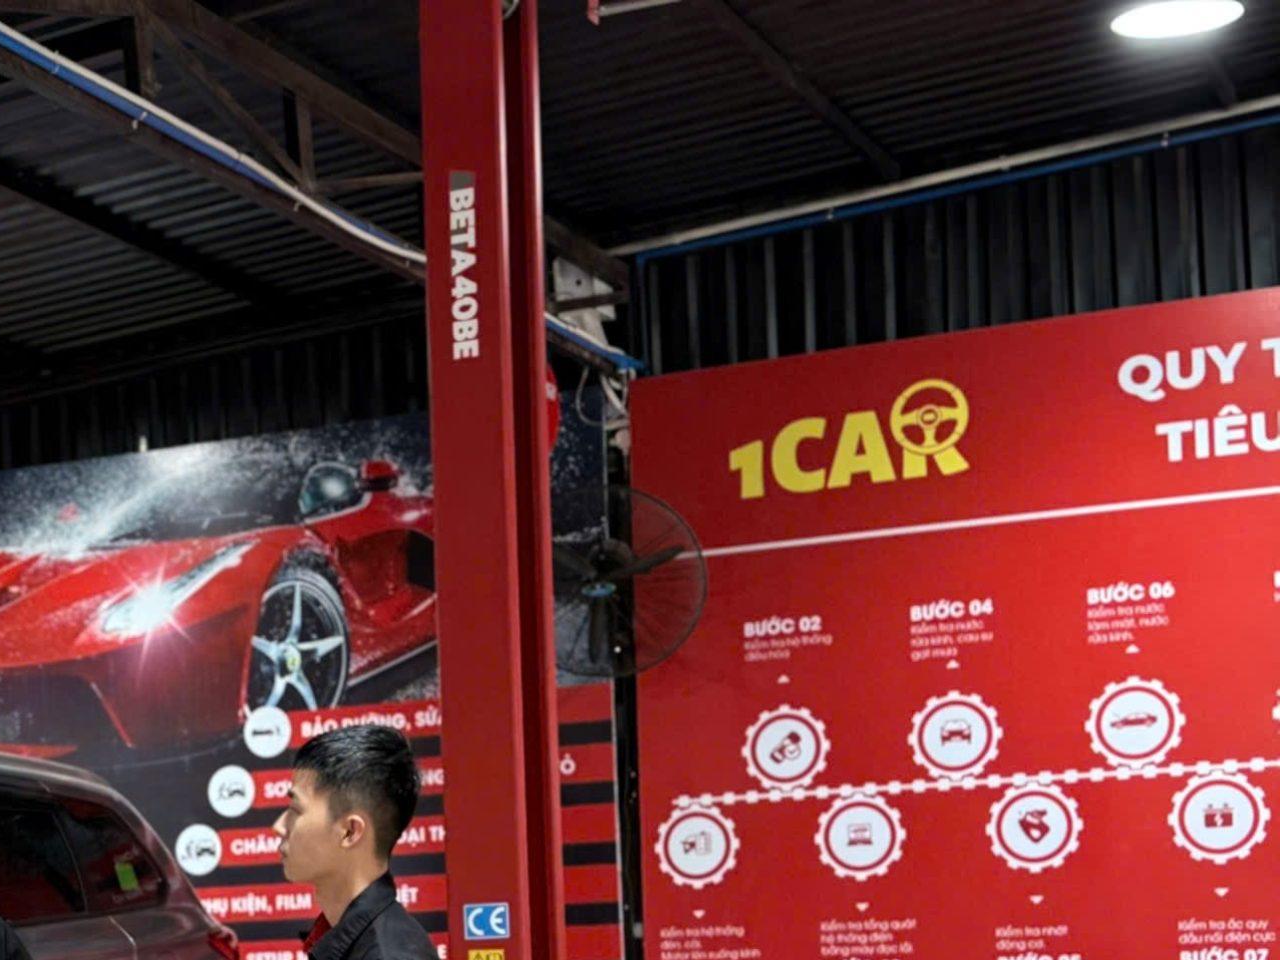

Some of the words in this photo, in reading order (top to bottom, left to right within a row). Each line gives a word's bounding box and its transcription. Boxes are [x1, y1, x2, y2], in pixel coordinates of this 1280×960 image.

[1118, 341, 1248, 402] QUY
[729, 378, 970, 499] 1CAR
[1155, 403, 1280, 463] TIÊU
[1087, 581, 1145, 605] BƯỚC
[1149, 581, 1176, 599] 06
[910, 599, 963, 622] BƯỚC
[969, 598, 994, 616] 04
[799, 615, 822, 633] 02
[275, 893, 313, 911] FILM
